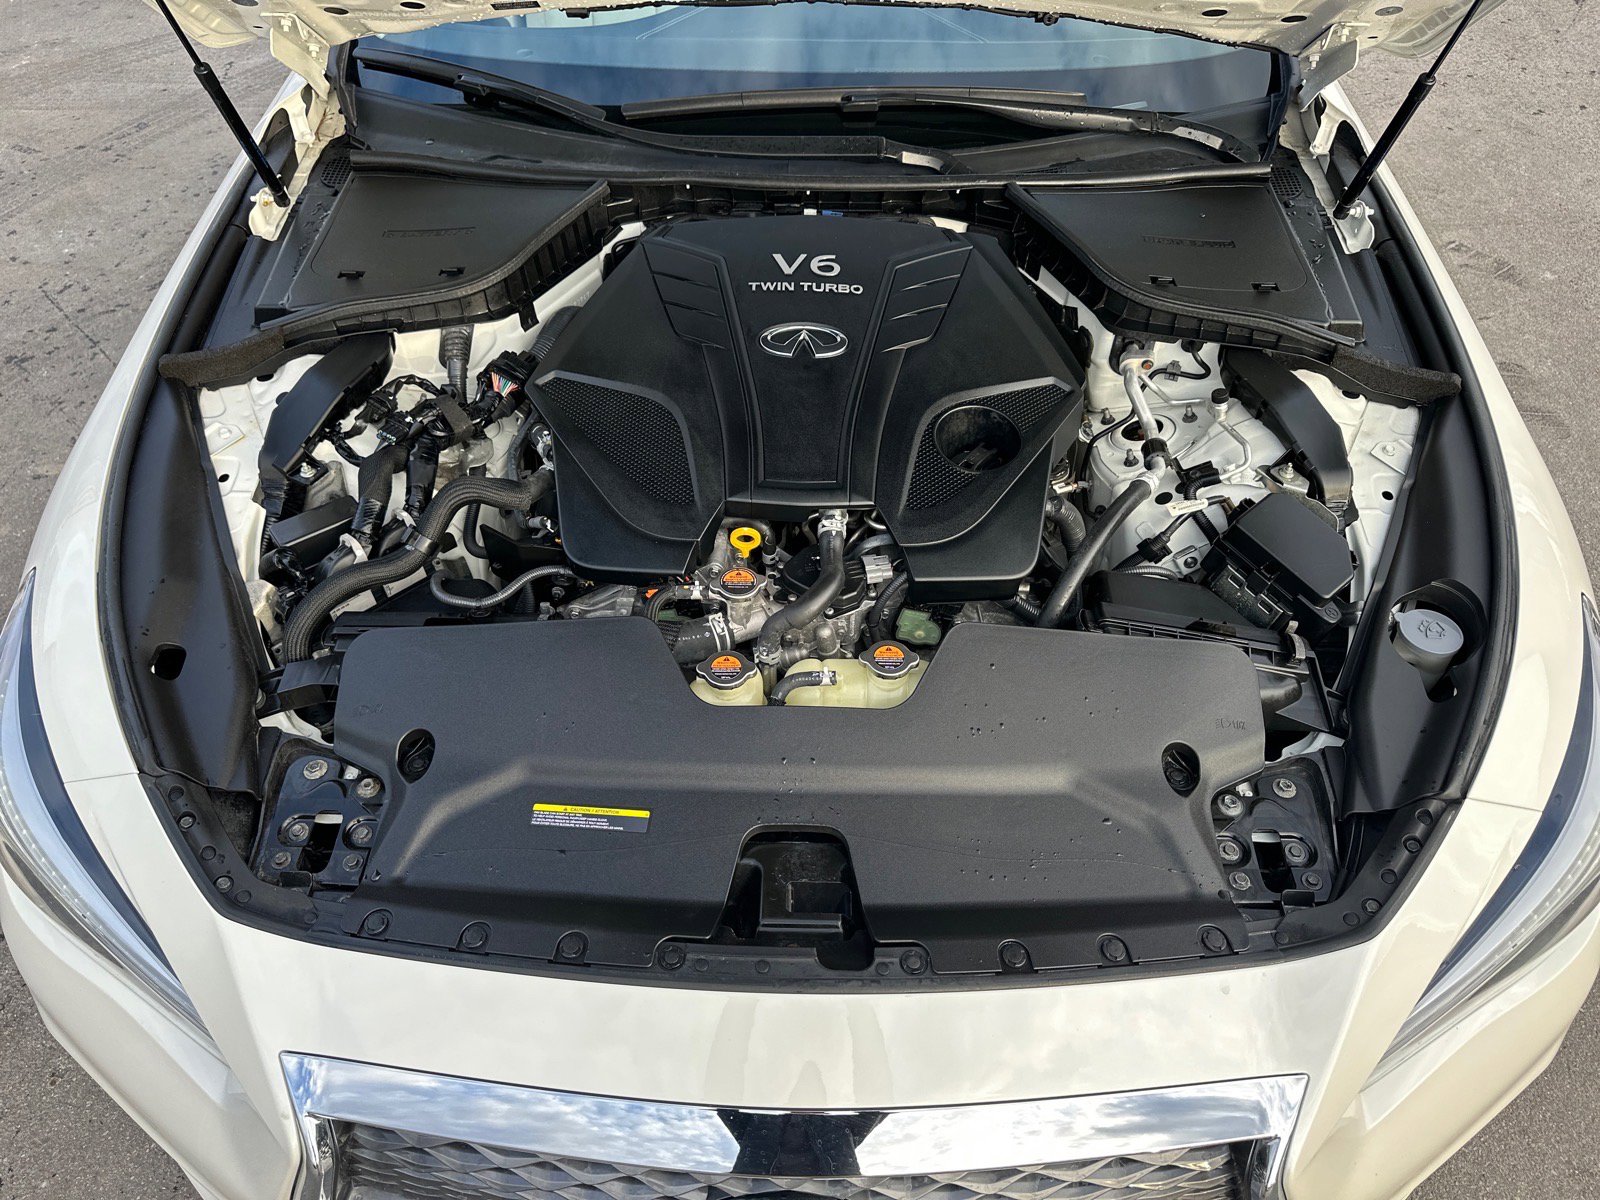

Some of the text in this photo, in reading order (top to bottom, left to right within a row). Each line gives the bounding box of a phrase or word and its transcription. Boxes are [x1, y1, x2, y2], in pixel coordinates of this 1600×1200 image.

[772, 253, 841, 276] V6
[748, 282, 864, 294] TWIN TURBO
